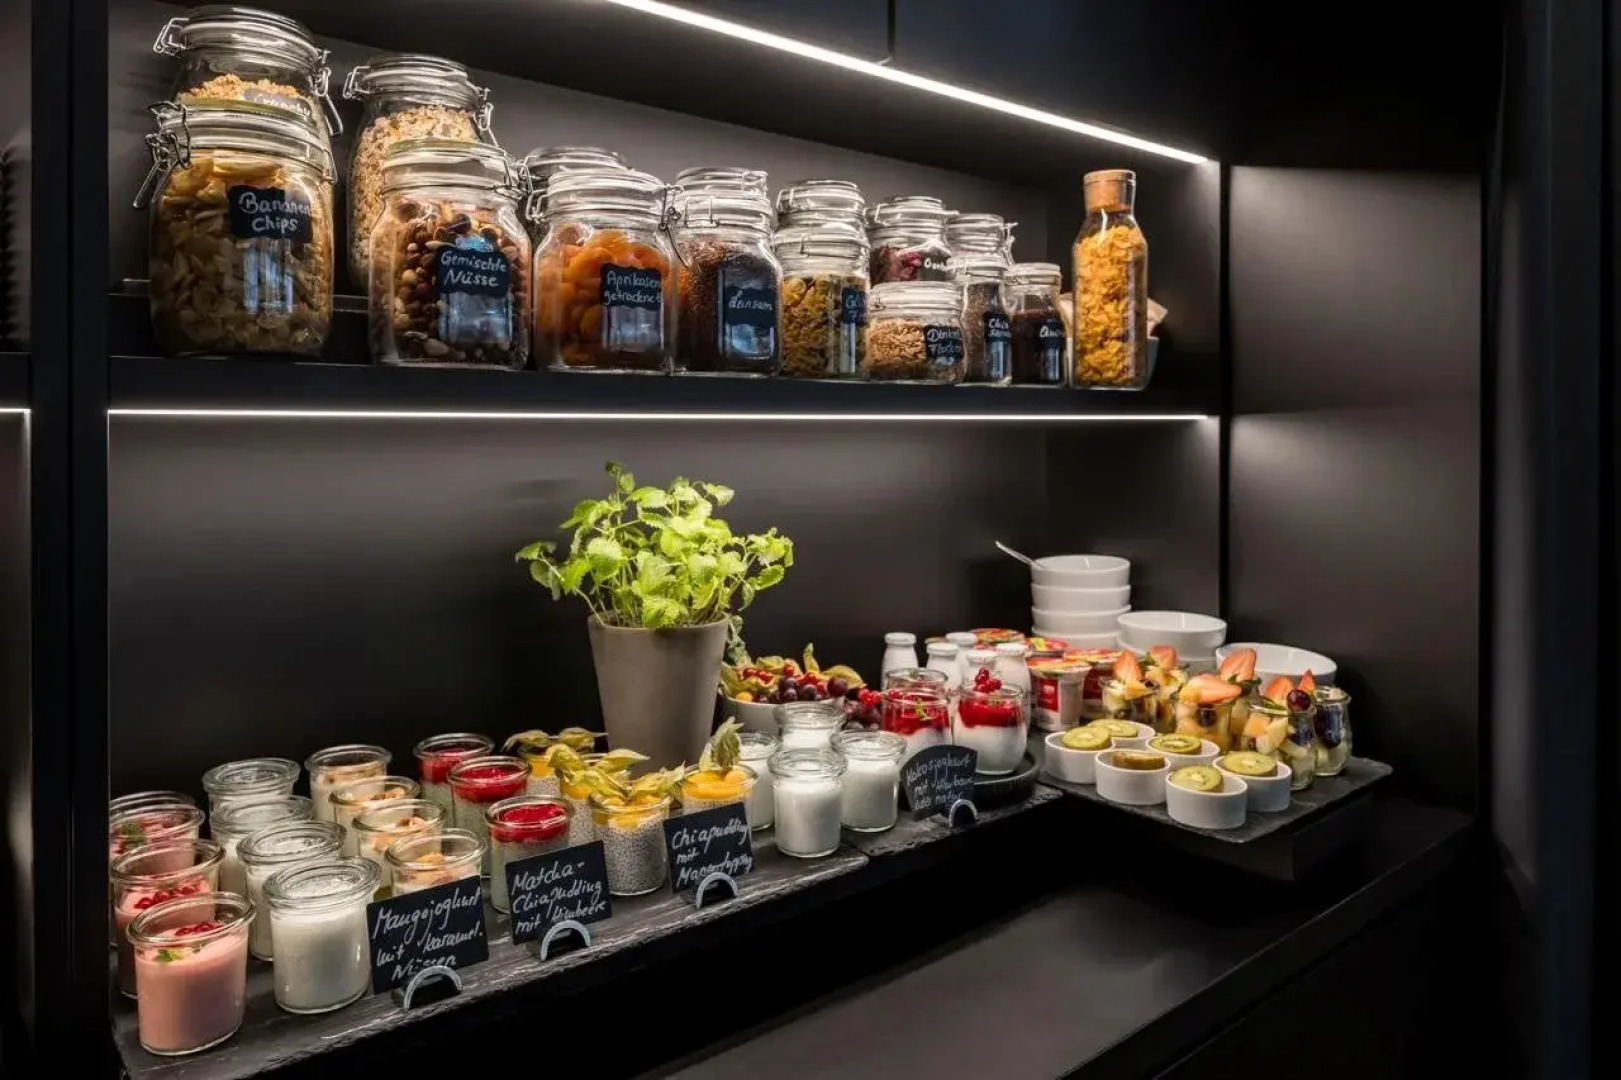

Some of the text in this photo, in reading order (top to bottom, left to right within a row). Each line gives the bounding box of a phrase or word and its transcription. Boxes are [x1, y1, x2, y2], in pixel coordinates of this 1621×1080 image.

[441, 251, 507, 272] Gemischte
[443, 269, 499, 287] Nüsse
[676, 846, 700, 865] mit
[515, 913, 541, 936] mit
[376, 943, 405, 967] mit
